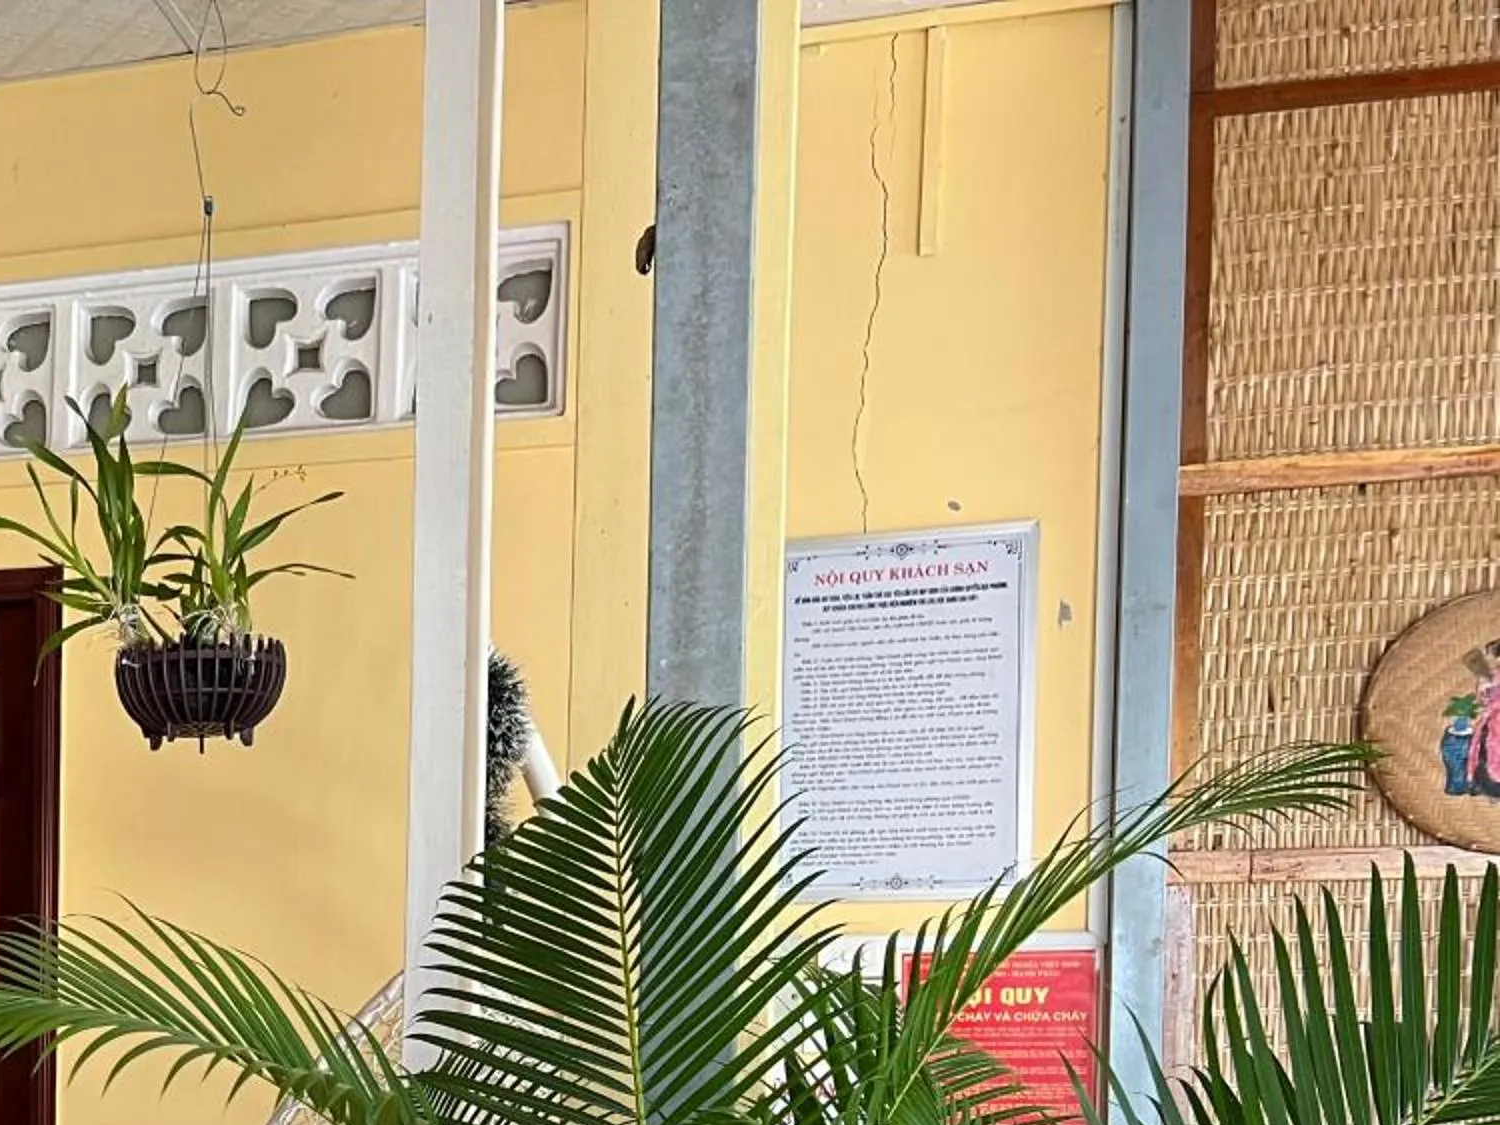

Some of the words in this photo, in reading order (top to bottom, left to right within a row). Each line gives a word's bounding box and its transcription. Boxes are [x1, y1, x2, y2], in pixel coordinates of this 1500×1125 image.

[814, 569, 844, 588] NỘI
[849, 568, 884, 585] QUY
[888, 563, 949, 581] KHÁCH
[953, 560, 989, 577] SẠN
[1000, 986, 1049, 1006] QUY
